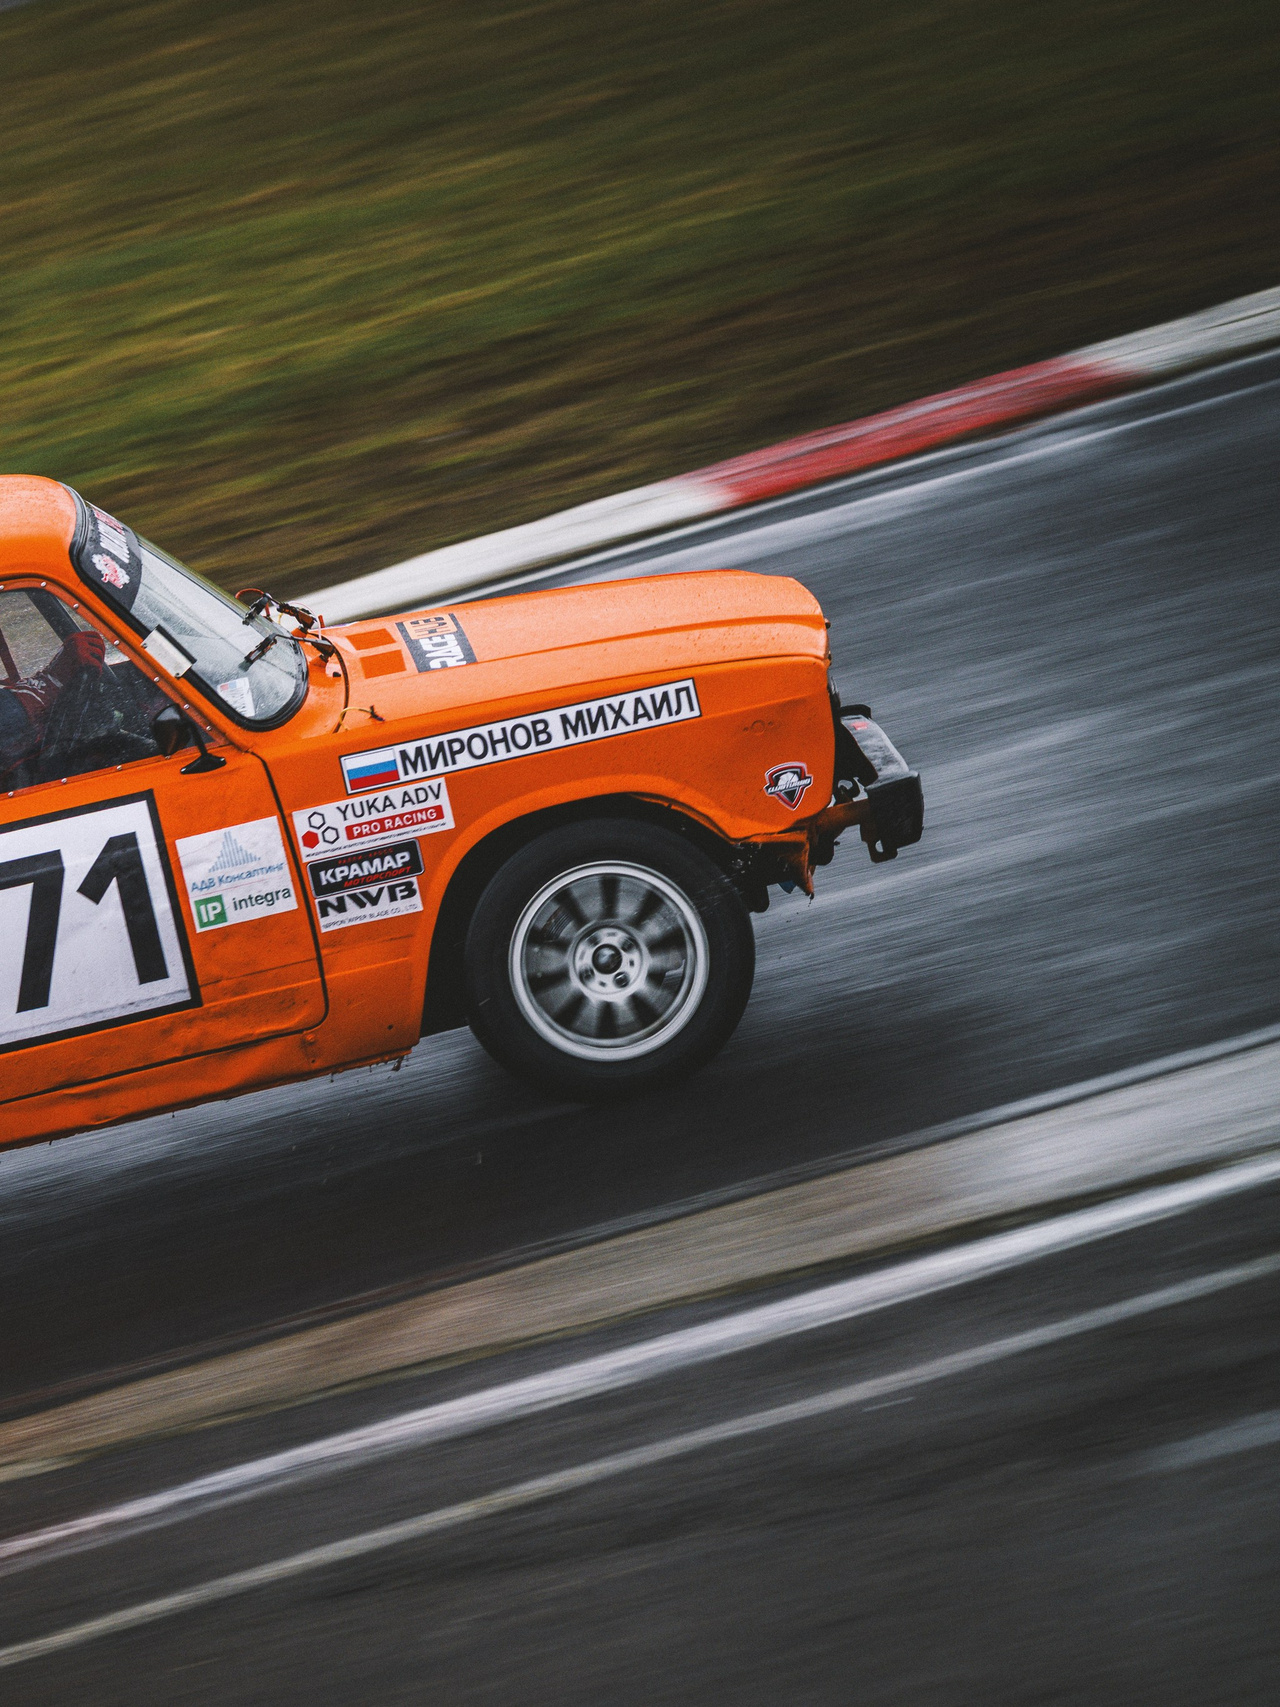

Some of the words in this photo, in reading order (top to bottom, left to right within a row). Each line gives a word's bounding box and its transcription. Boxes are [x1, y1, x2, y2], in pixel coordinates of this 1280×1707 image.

[419, 633, 467, 669] RACE
[399, 719, 552, 776] МИРОНОВ
[560, 687, 695, 740] МИХАИЛ
[336, 795, 398, 822] YUKA
[400, 783, 442, 808] ADV
[352, 822, 380, 838] PRO
[384, 808, 438, 830] RACING
[190, 877, 216, 893] АДВ
[219, 862, 285, 885] Консалтинг
[319, 851, 411, 886] КРАМАР
[343, 866, 412, 888] МОТОРСПОРТ
[199, 901, 222, 923] IP
[232, 887, 292, 912] integra
[317, 880, 418, 919] NWB
